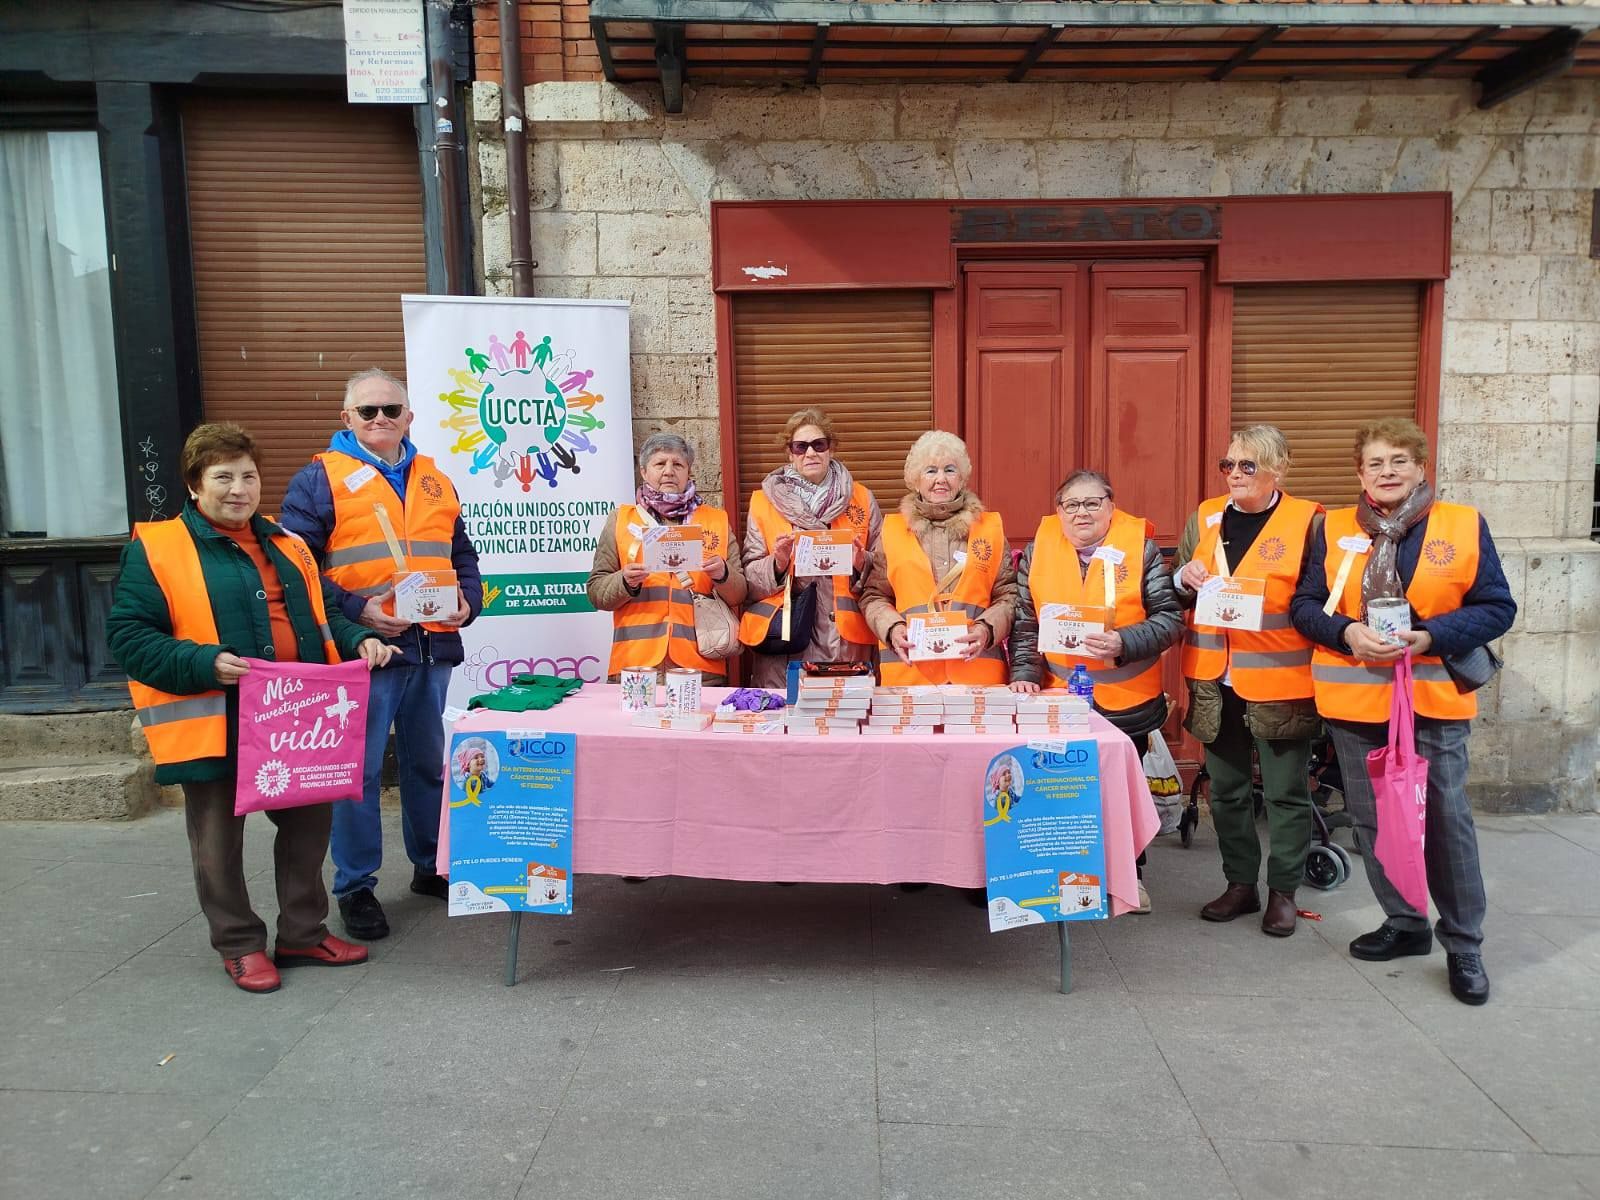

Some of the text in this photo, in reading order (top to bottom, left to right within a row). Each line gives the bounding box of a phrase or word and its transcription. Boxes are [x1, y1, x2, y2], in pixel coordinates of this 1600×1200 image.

[960, 206, 1213, 240] BEATO
[488, 399, 558, 426] UCCTA
[461, 500, 513, 518] CIACIÓN
[516, 502, 566, 517] UNIDOS
[568, 501, 616, 517] CONTRA
[478, 518, 527, 537] CÁNCER
[530, 520, 545, 535] DE
[546, 520, 581, 535] TORO
[583, 520, 591, 534] Y
[474, 537, 598, 554] OVINCIA DE ZAMORA
[505, 584, 541, 597] CAJA
[506, 598, 567, 608] DE ZAMORA
[263, 677, 304, 705] Más
[254, 691, 330, 723] investigación
[270, 716, 344, 753] vida
[526, 741, 566, 755] ICCD
[1049, 750, 1089, 765] ICCD
[1037, 776, 1085, 784] INTERNACIONAL
